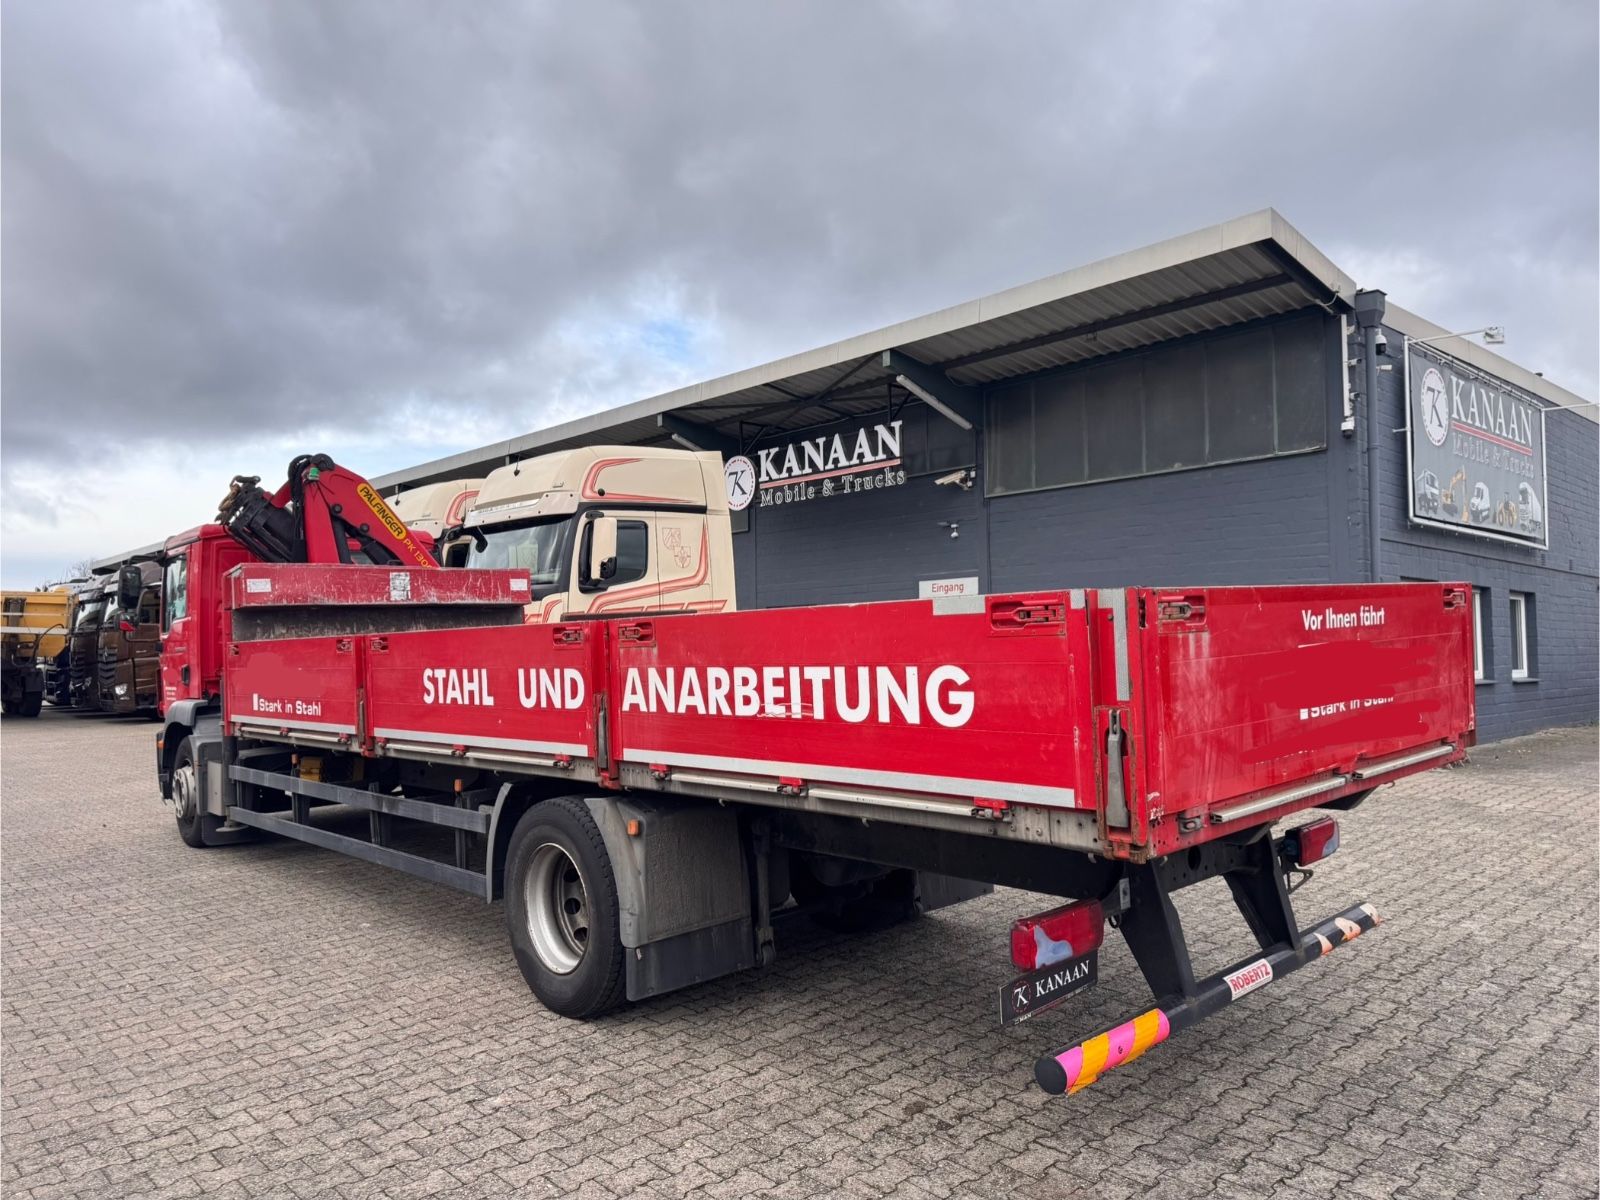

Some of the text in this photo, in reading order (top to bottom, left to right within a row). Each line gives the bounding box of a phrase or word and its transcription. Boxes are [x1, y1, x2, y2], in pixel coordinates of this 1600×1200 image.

[1450, 375, 1533, 446] KANAAN
[757, 420, 903, 482] KANAAN
[760, 467, 905, 507] Mobile & Trucks
[360, 487, 433, 568] PALFINGER PK 130
[931, 583, 965, 595] Eingang
[1302, 605, 1385, 631] Vor Ihnen fährt
[259, 700, 322, 716] Stark in Stahl
[422, 664, 975, 729] STAHL UND ANARBEITUNG
[1035, 960, 1090, 997] KANAAN
[1230, 963, 1271, 992] ROBERTZ
